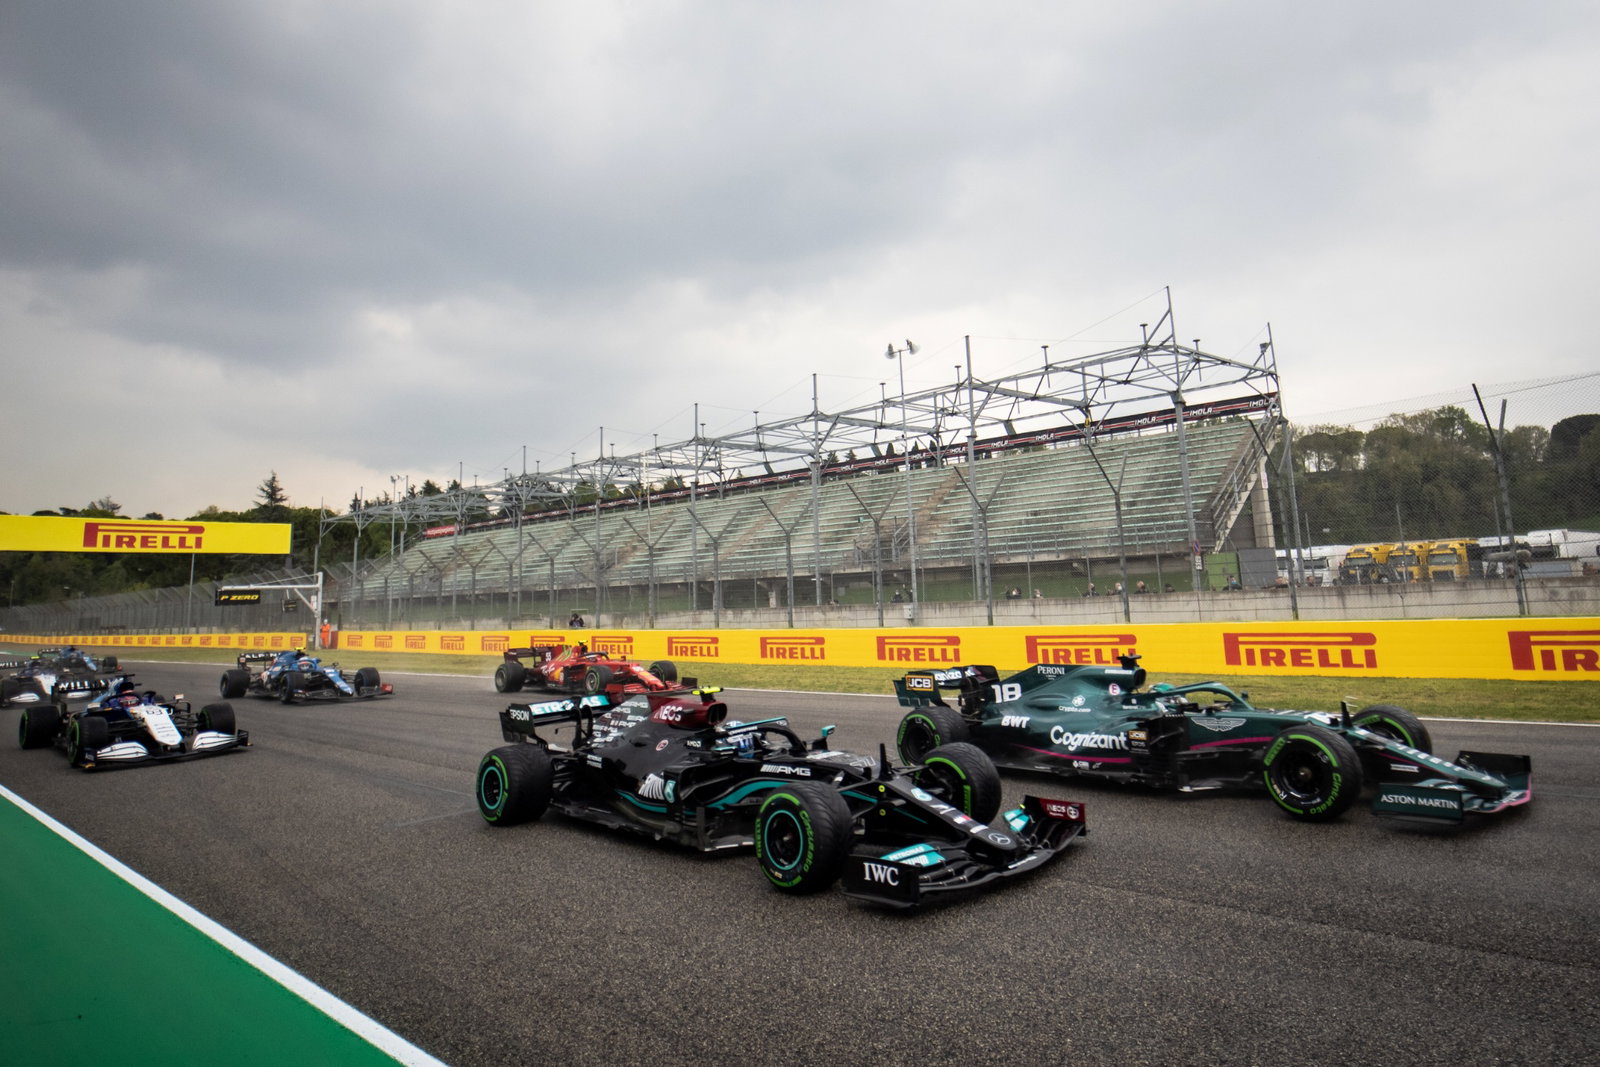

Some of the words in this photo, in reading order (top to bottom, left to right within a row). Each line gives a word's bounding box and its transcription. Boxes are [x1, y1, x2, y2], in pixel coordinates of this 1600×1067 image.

[1189, 407, 1212, 416] IMOLA
[1134, 416, 1156, 425] IMOLA
[1035, 433, 1054, 441] IMOLA
[83, 522, 205, 549] PIRELLI
[440, 635, 464, 650] PIRELLI
[481, 635, 509, 651] PIRELLI
[591, 635, 633, 655] PIRELLI
[667, 636, 719, 657] PIRELLI
[759, 636, 825, 659] PIRELLI
[876, 635, 961, 662] PIRELLI
[1223, 632, 1378, 668] PIRELLI
[1037, 665, 1065, 675] PERONI
[908, 677, 931, 688] JCB
[991, 683, 1022, 704] 18
[510, 709, 530, 721] EPSON
[1058, 705, 1091, 713] crypto.com
[1001, 715, 1030, 728] BWT
[1050, 725, 1129, 751] Cognizant
[777, 765, 811, 776] AMG
[1381, 794, 1416, 804] ASTON
[1418, 795, 1459, 809] MARTIN
[863, 862, 900, 886] IWC
